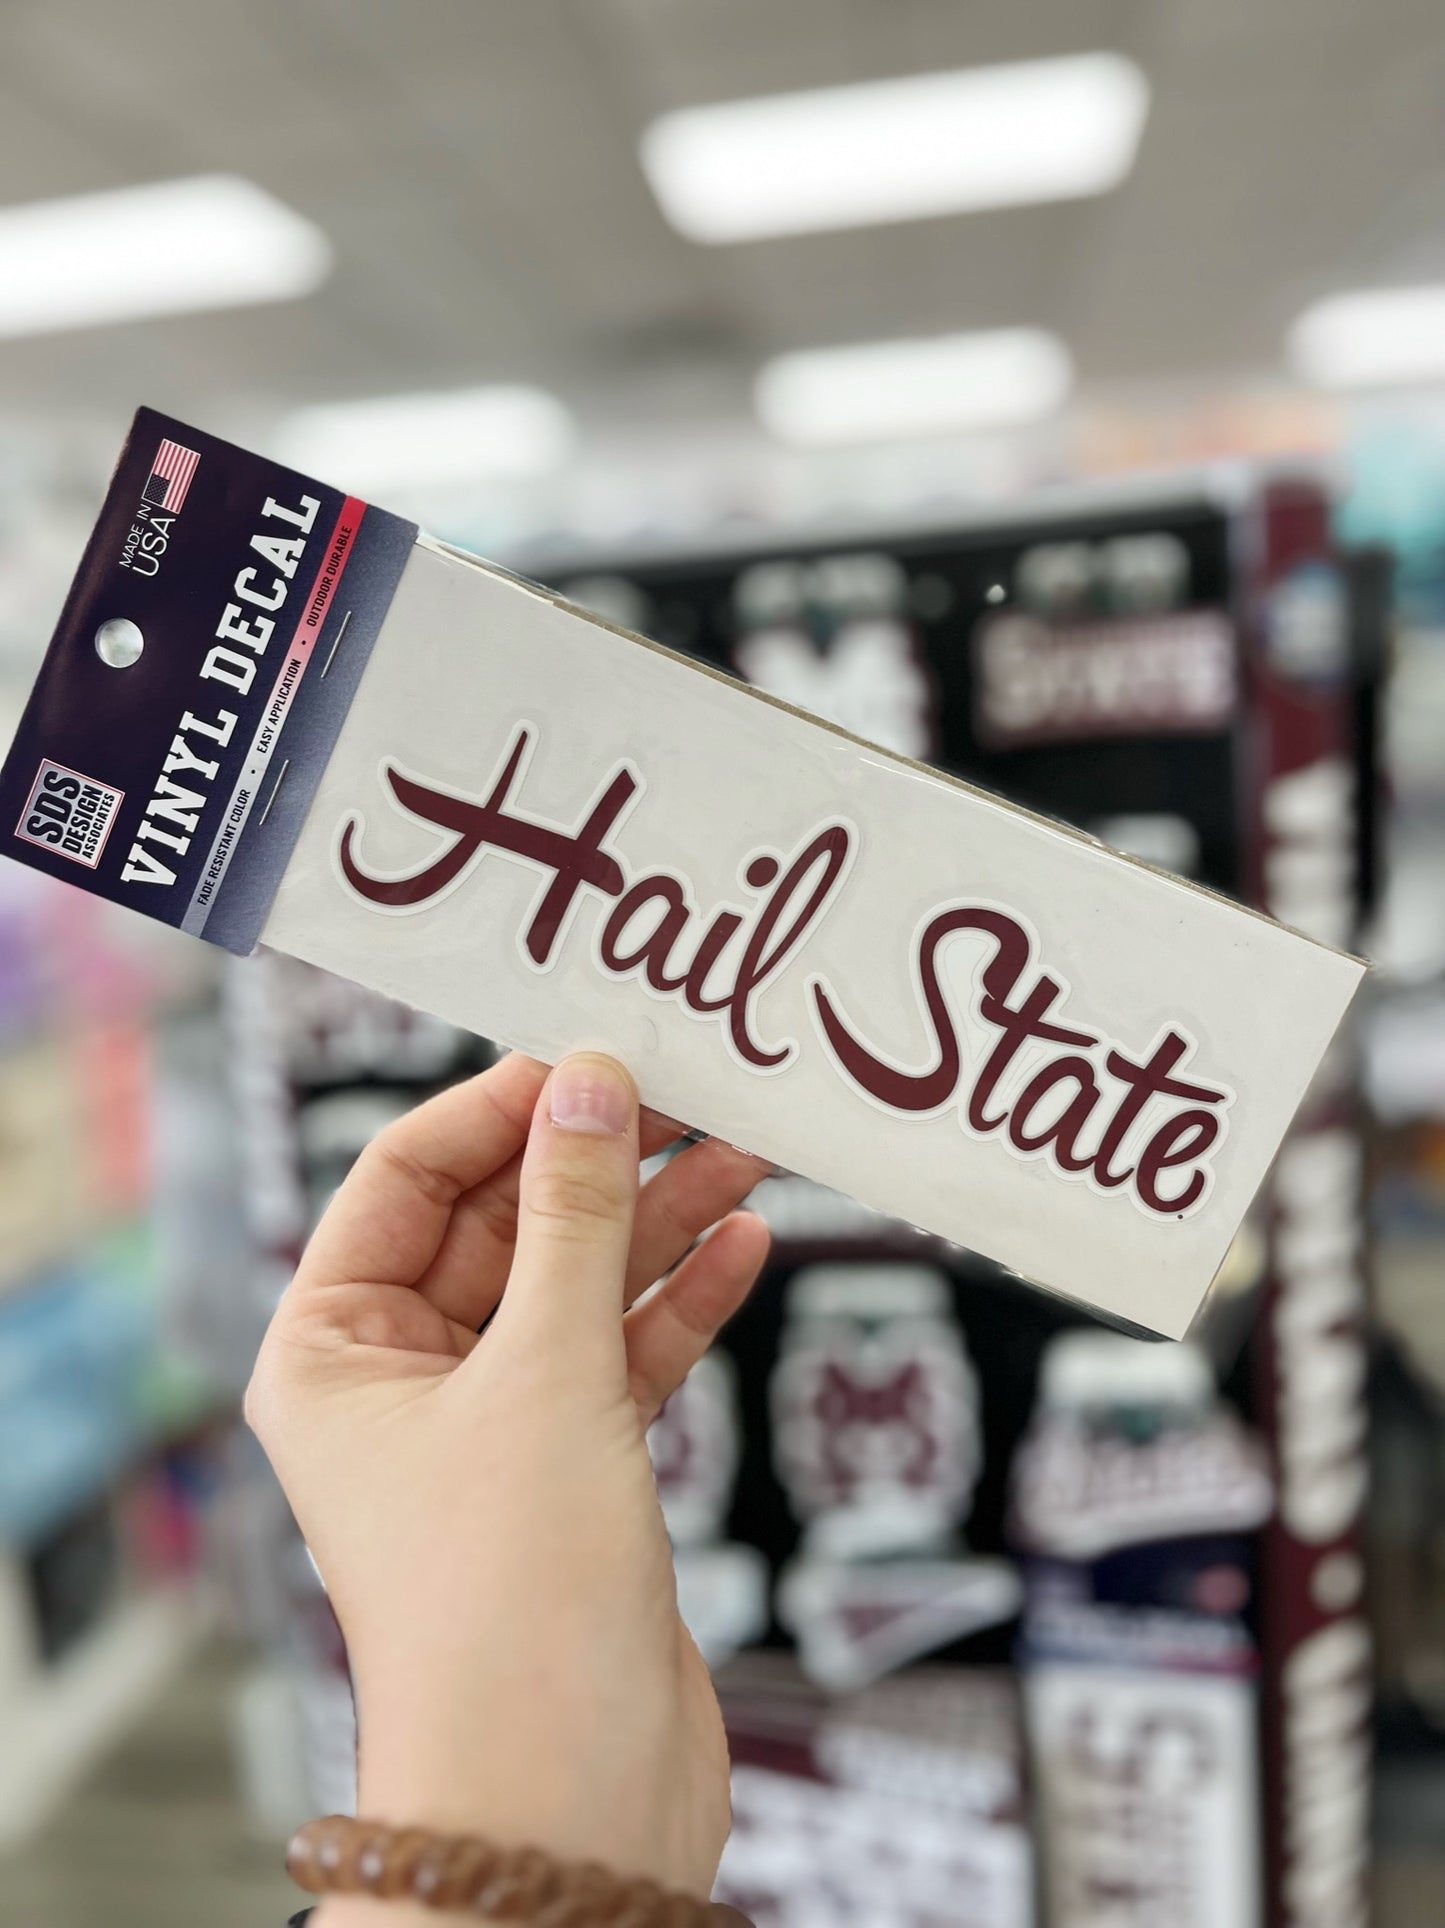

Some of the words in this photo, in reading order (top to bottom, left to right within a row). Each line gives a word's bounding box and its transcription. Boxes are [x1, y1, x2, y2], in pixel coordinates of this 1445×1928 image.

[119, 523, 145, 568] MADE
[136, 503, 152, 521] IN
[132, 517, 176, 576] USA
[306, 576, 333, 627] OUTDOOR
[326, 525, 353, 576] DURABLE
[120, 711, 239, 887] VINYL
[200, 494, 321, 695] DECAL
[256, 725, 275, 754] EASY
[268, 658, 302, 726] APPLICATION
[26, 770, 81, 844] SDS
[61, 784, 104, 854] DESIGN
[82, 792, 115, 859] ASSOCIATES
[197, 879, 216, 906] FADE
[208, 822, 237, 880] RESISTANT
[230, 788, 252, 823] COLOR
[341, 728, 849, 1066] Hail
[814, 907, 1225, 1212] State
